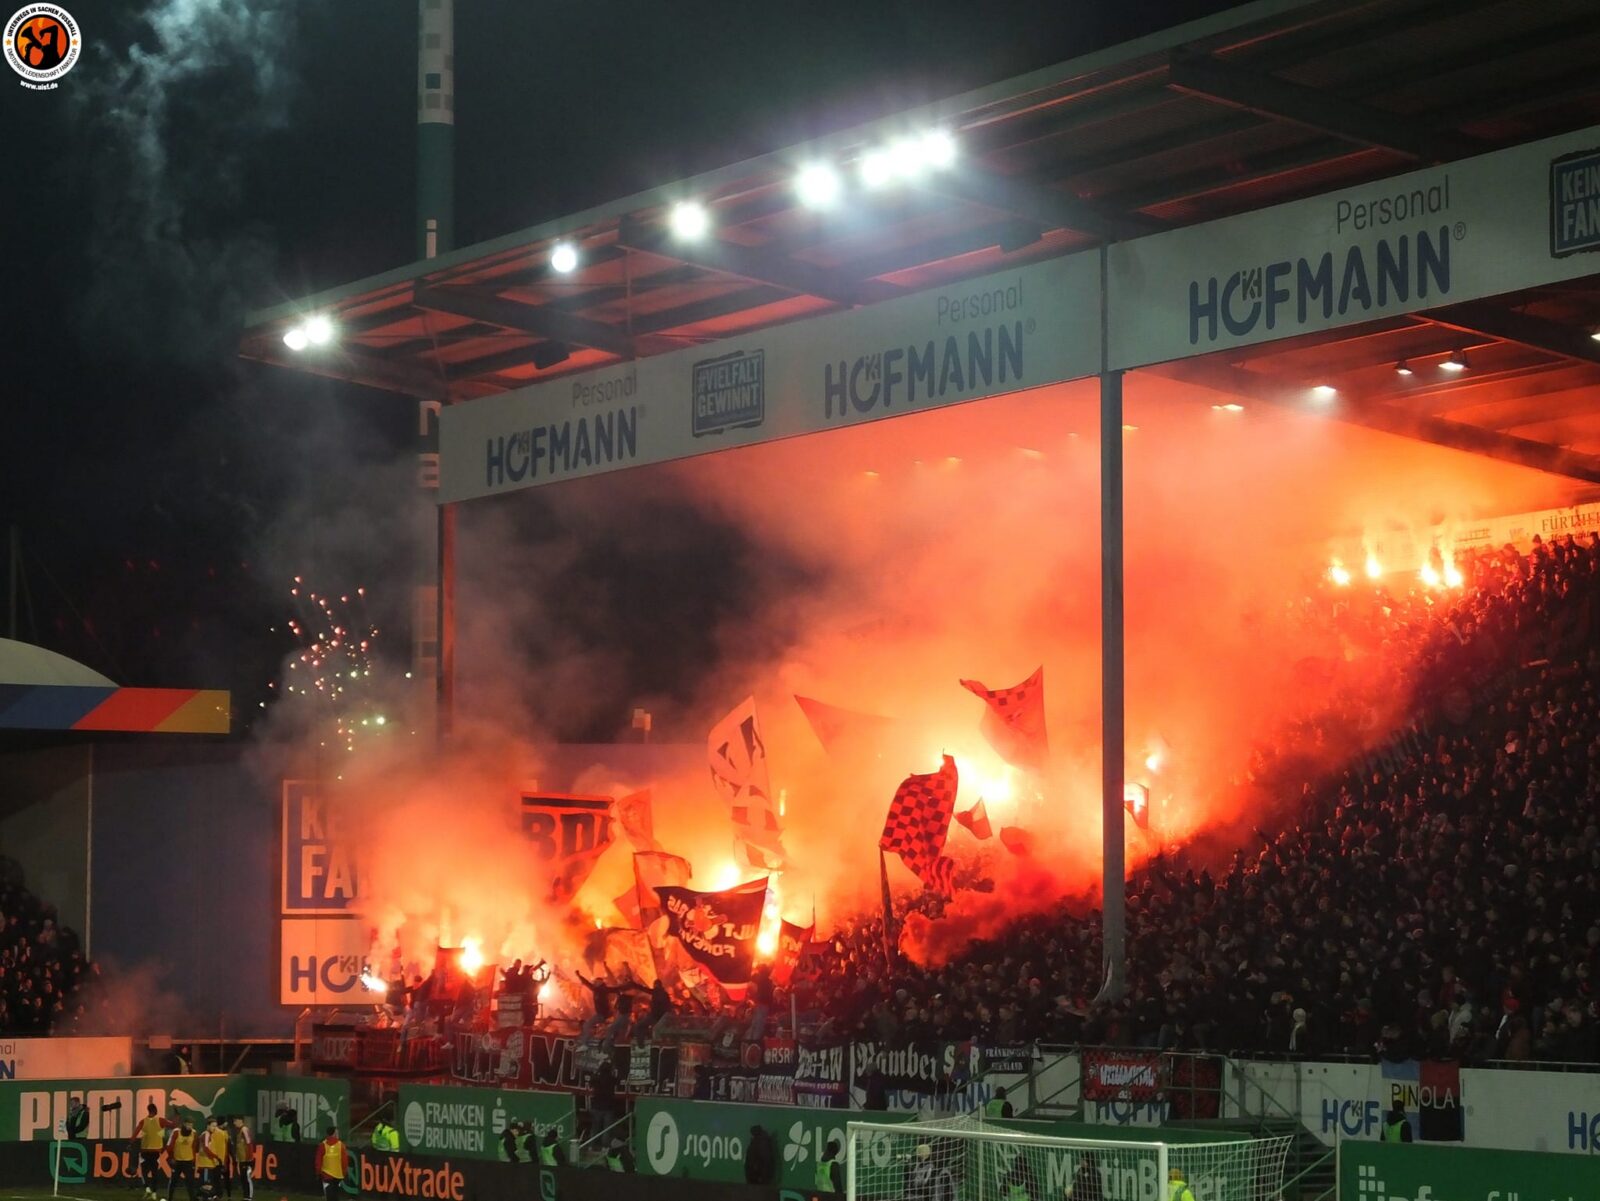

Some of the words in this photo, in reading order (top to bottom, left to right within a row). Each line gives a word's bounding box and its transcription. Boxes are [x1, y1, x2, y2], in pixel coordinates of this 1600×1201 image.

[1337, 174, 1449, 234] Personal
[938, 278, 1022, 325] Personal
[572, 371, 637, 408] Personal
[698, 384, 759, 417] GEWINNT
[425, 1102, 484, 1126] FRANKEN
[1391, 1083, 1455, 1110] PINOLA
[426, 1129, 484, 1152] BRUNNEN
[683, 1133, 743, 1168] signia
[360, 1154, 464, 1201] buXtrade
